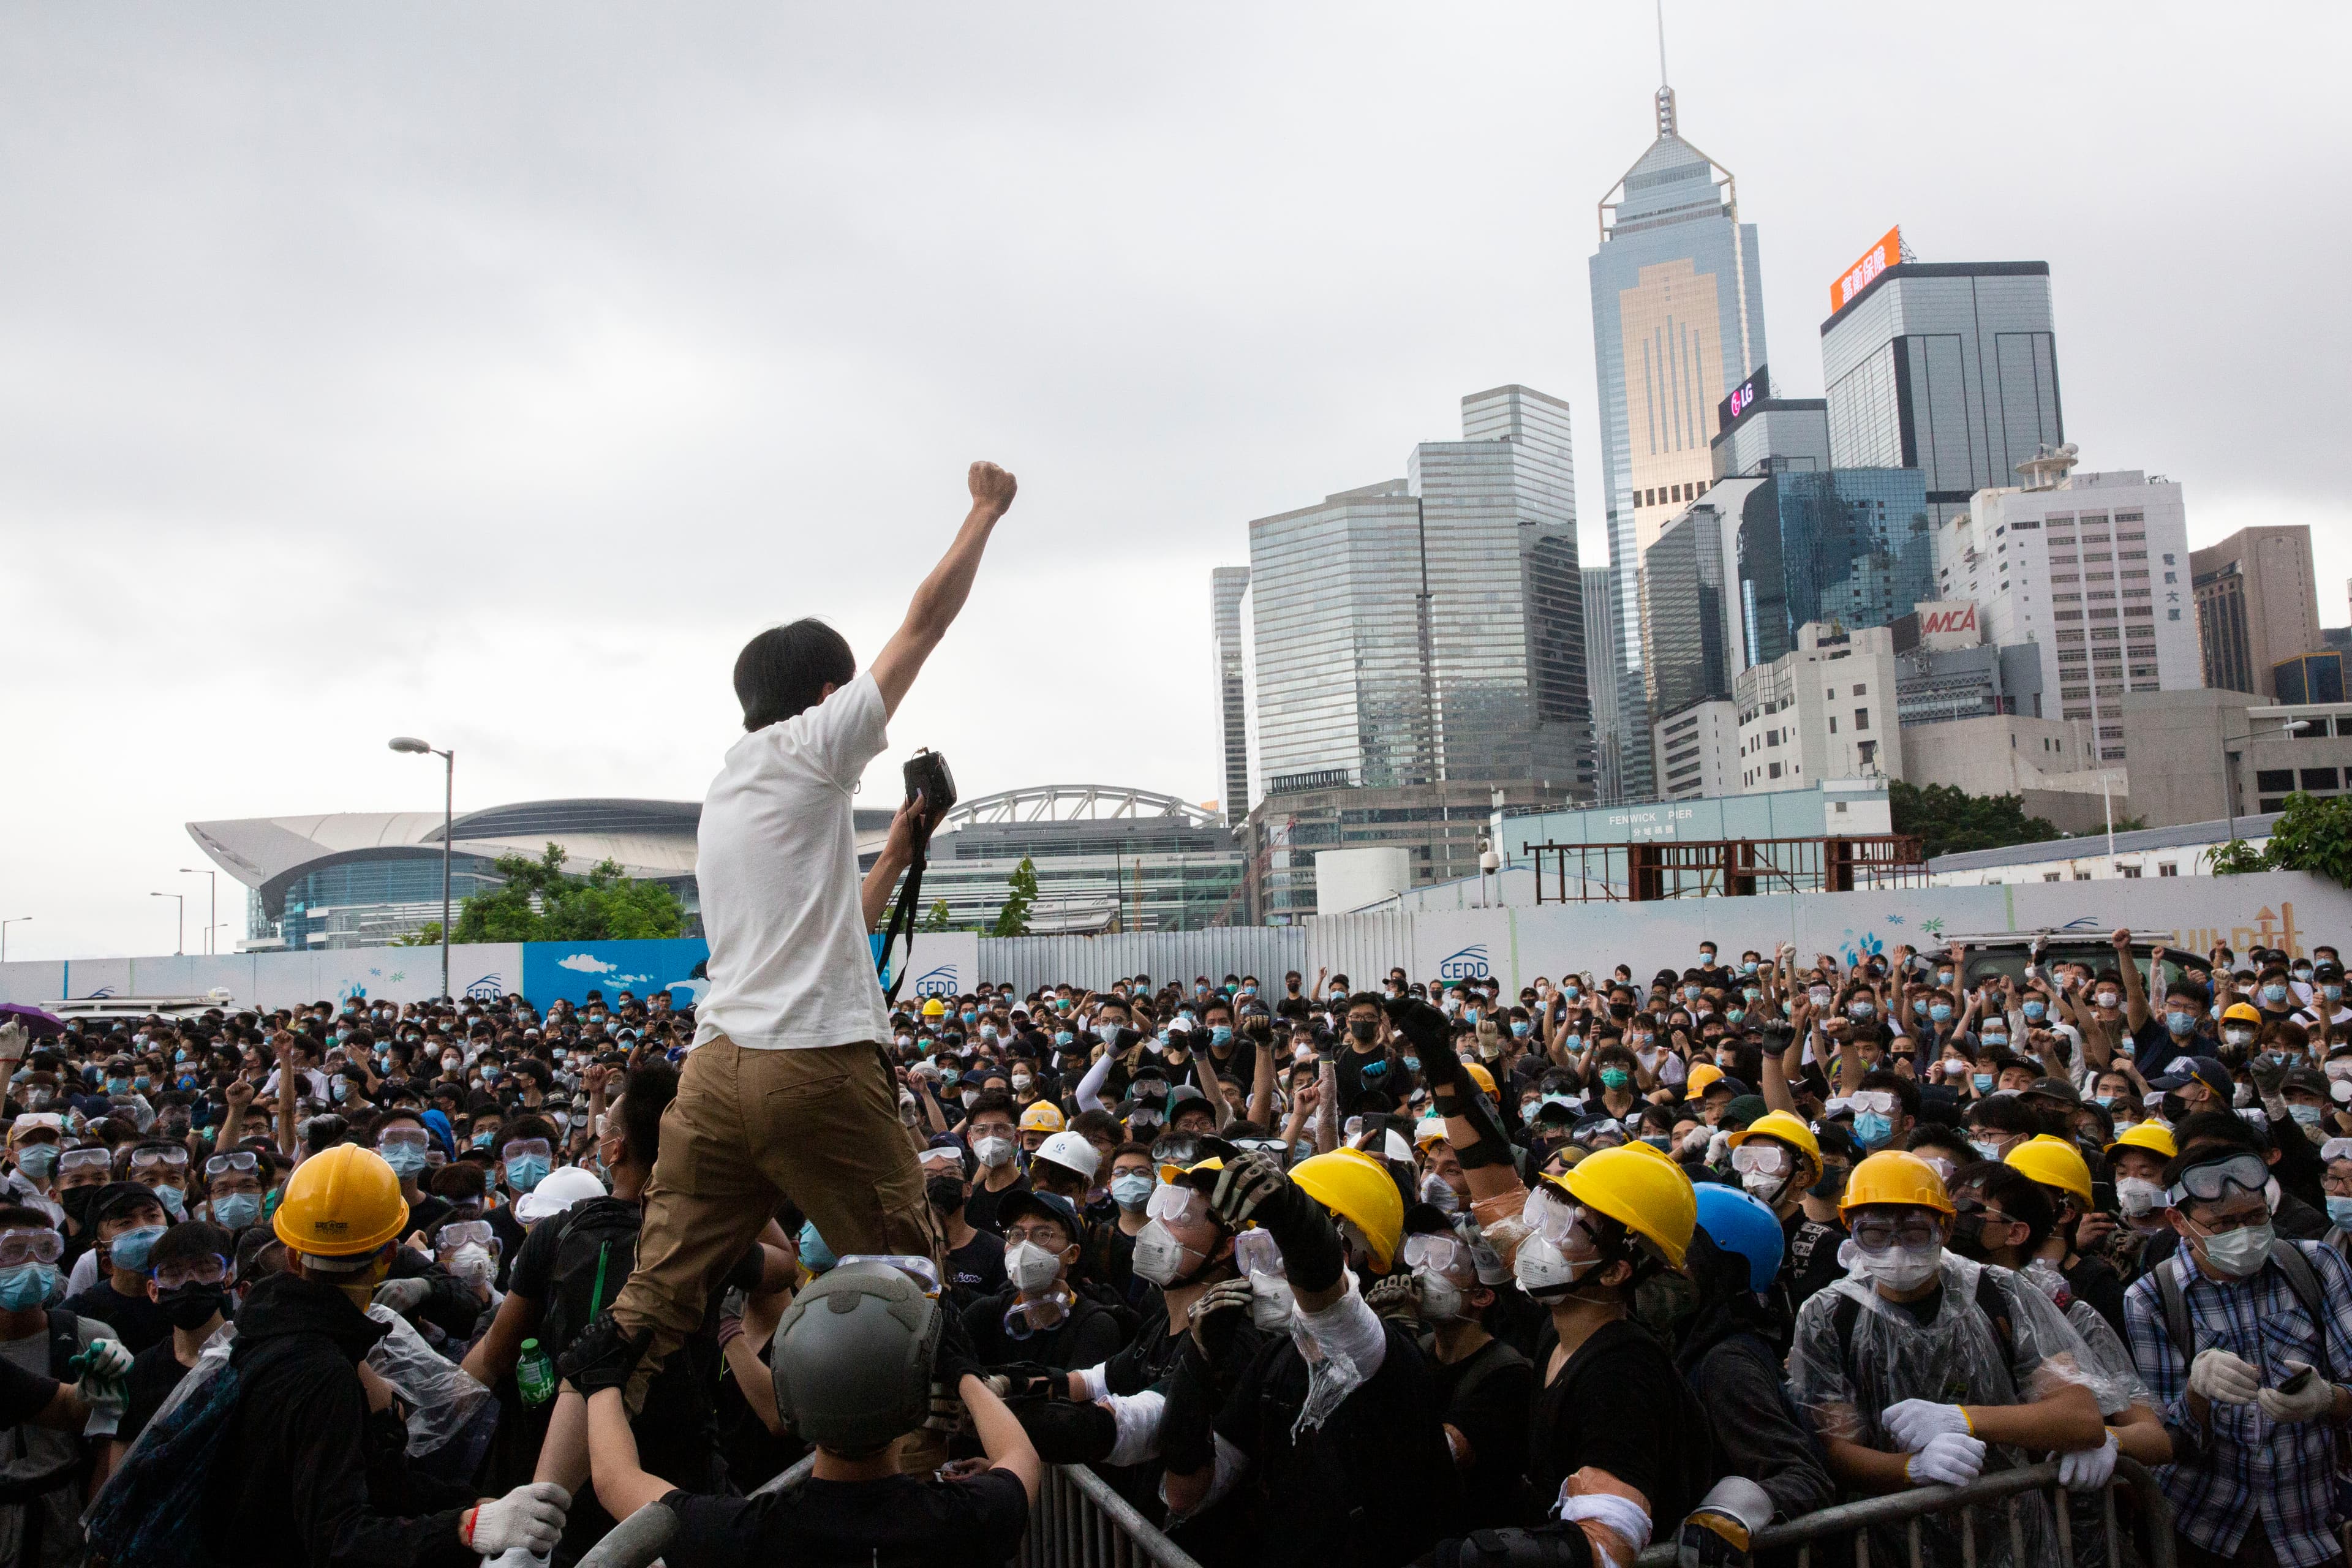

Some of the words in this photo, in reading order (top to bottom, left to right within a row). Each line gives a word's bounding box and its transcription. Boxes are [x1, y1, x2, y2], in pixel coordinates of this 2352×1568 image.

[1842, 245, 1887, 304] 富衛保險
[1741, 383, 1753, 408] LG
[1920, 603, 1975, 638] YMCA
[1609, 813, 1656, 825] FENWICK
[1668, 809, 1692, 820] PIER
[1441, 962, 1488, 979] CEDD
[916, 981, 957, 996] CEDD
